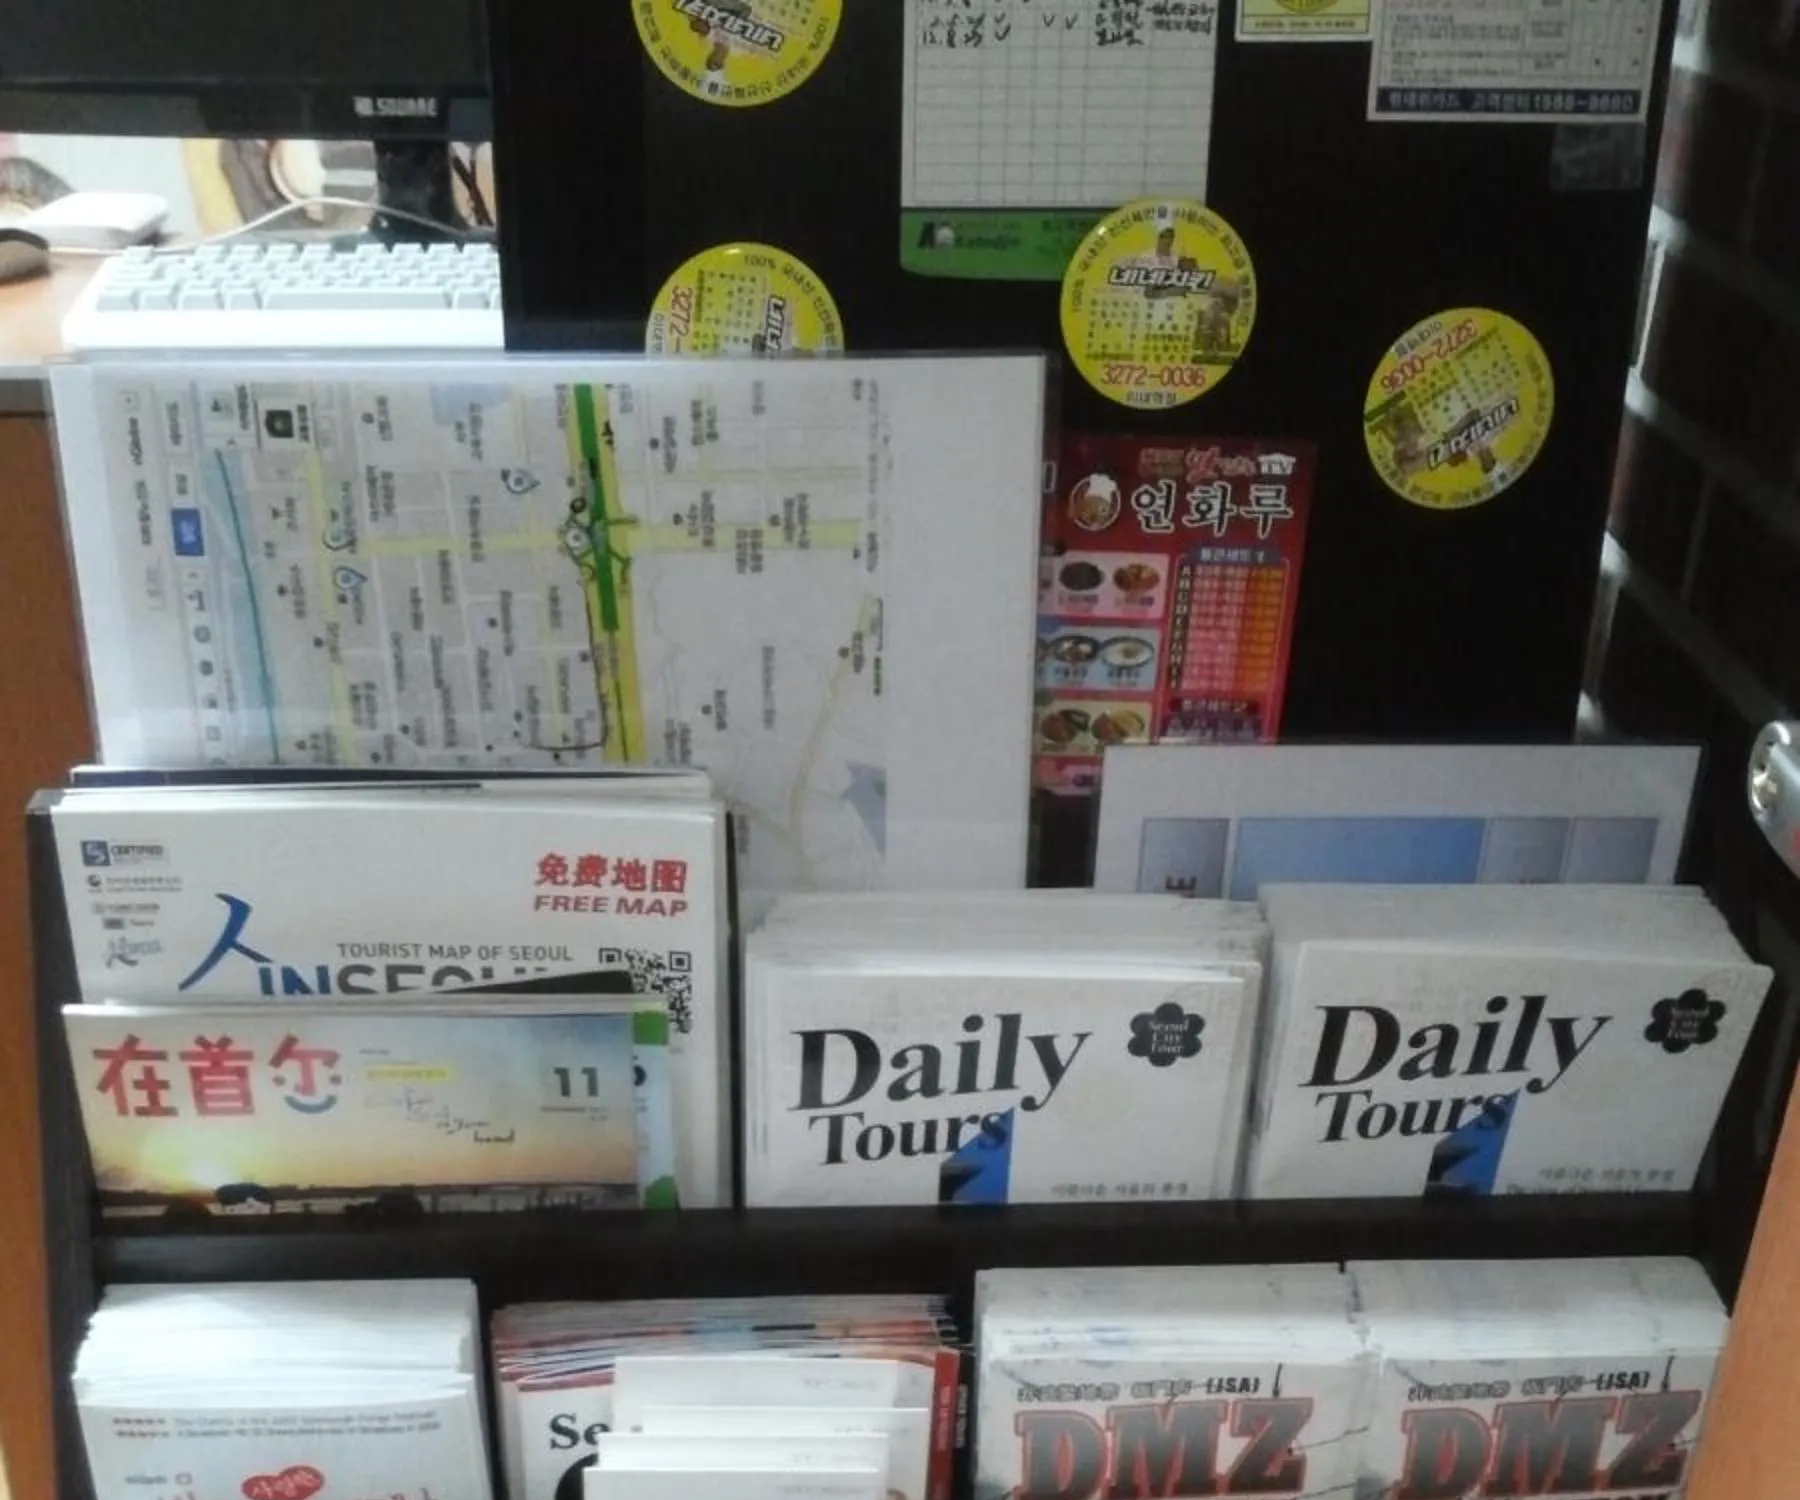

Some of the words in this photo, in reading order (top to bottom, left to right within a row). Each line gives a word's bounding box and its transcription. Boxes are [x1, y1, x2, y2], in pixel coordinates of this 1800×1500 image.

[533, 895, 610, 914] FREE
[615, 896, 688, 918] MAP
[337, 942, 422, 960] TOURIST
[428, 945, 472, 961] MAP
[477, 946, 503, 961] OF
[509, 945, 574, 962] SEOUL
[788, 1012, 1093, 1113] Daily
[1298, 994, 1614, 1095] Daily
[92, 1033, 344, 1117] 在首尔
[553, 1065, 600, 1099] 11
[808, 1111, 1009, 1167] Tours
[1315, 1088, 1511, 1143] Tours
